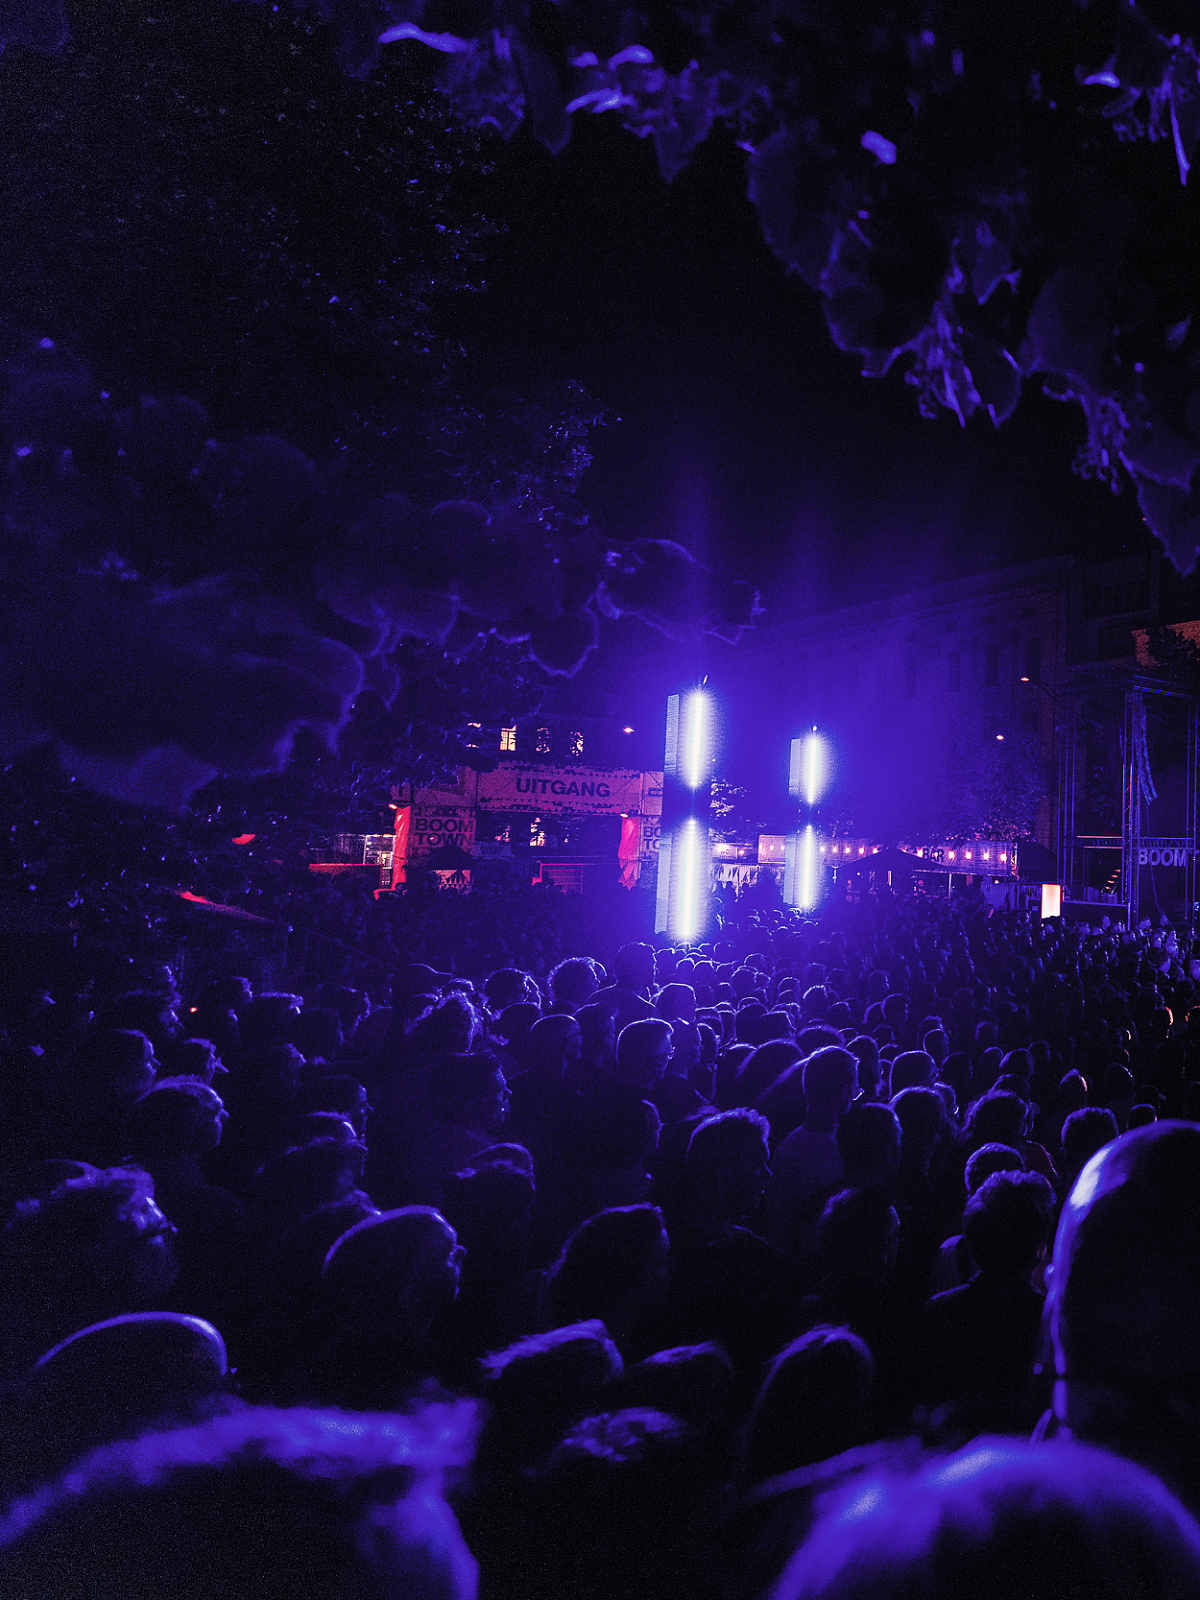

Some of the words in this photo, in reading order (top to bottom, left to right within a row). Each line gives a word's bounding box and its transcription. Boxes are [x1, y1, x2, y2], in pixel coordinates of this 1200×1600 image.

[516, 777, 610, 797] UITGANG
[415, 818, 474, 831] BOOM
[643, 826, 661, 837] BO
[414, 832, 474, 847] TOWN
[643, 838, 660, 850] TO
[922, 848, 944, 862] BAR
